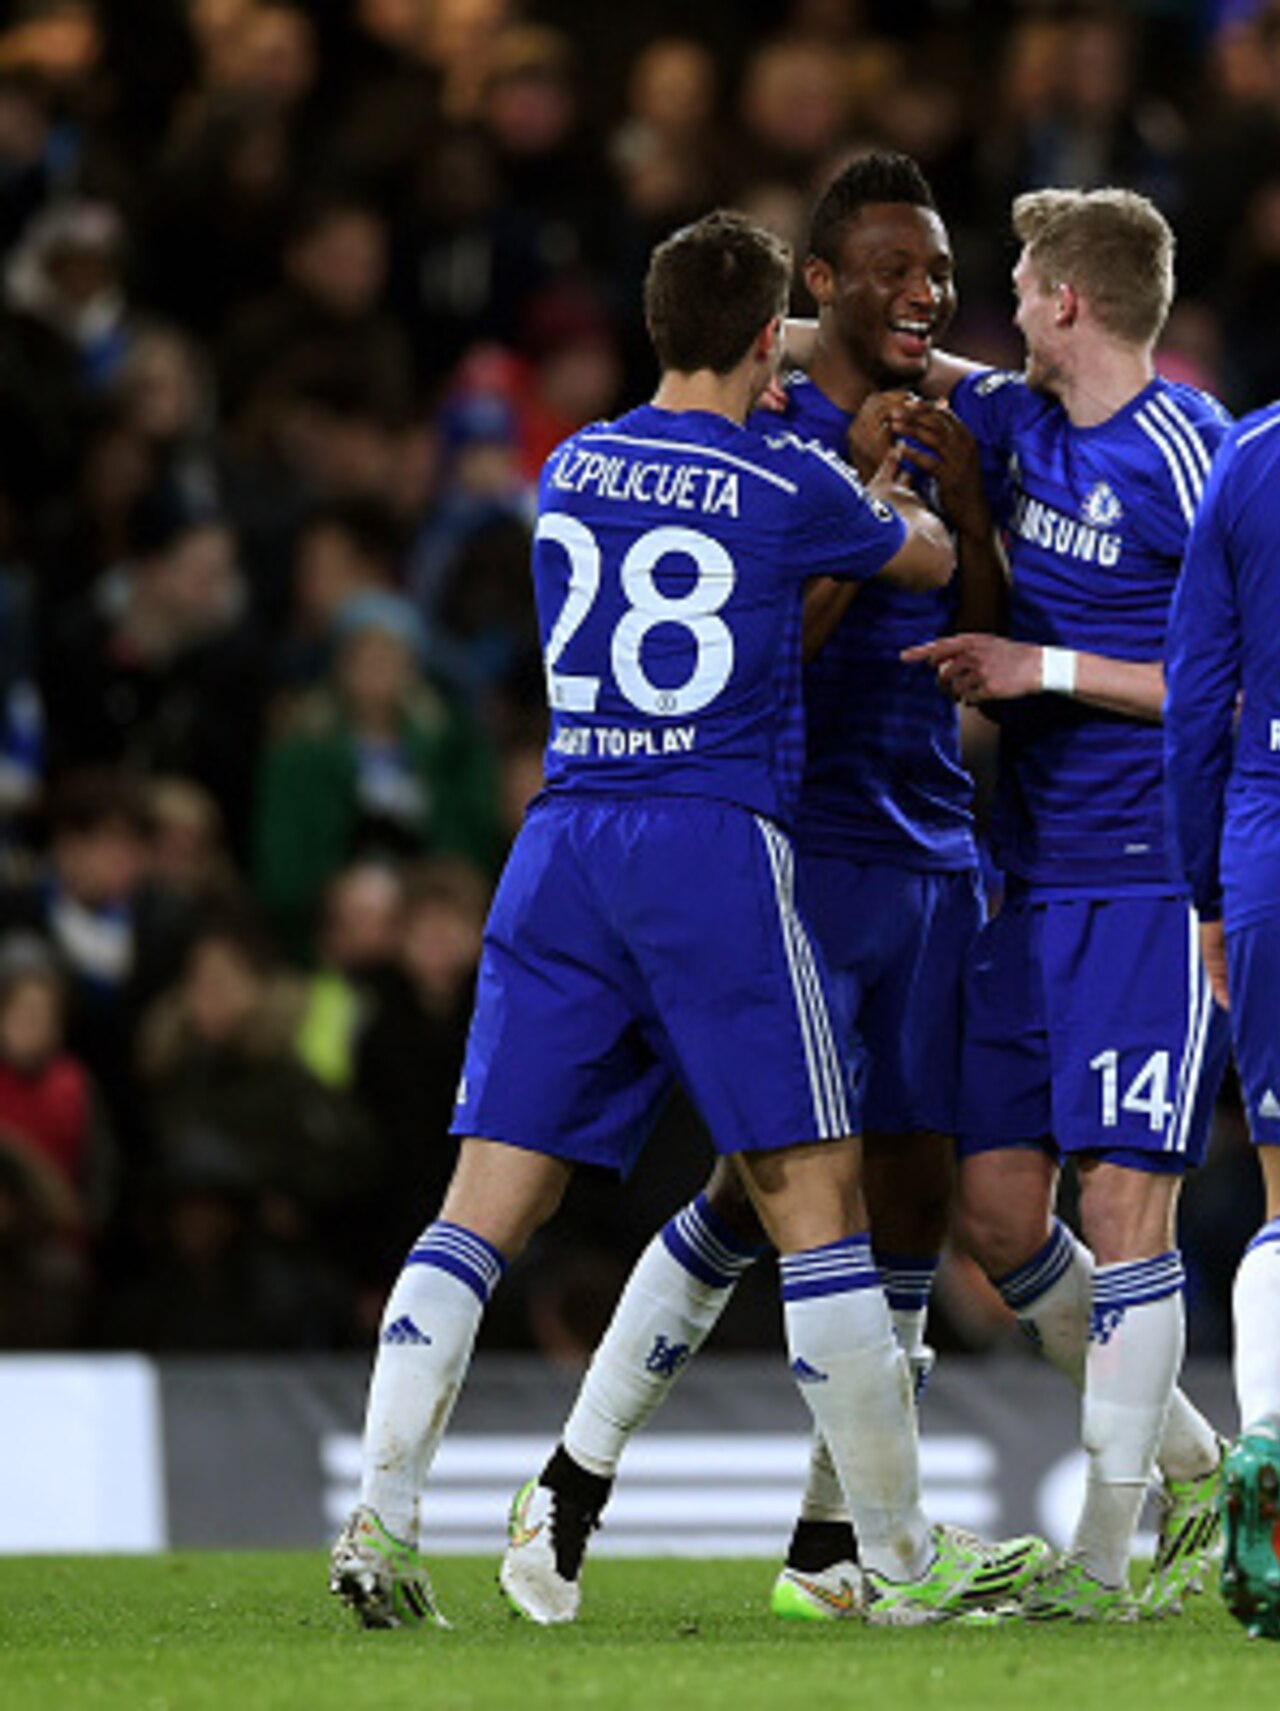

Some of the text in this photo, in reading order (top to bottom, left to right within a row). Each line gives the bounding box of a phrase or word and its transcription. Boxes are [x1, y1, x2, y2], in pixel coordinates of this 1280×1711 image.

[1014, 495, 1122, 567] MSUNG
[536, 512, 736, 717] 28
[594, 727, 627, 758] TO
[628, 724, 696, 756] PLAY
[1089, 1050, 1173, 1131] 14
